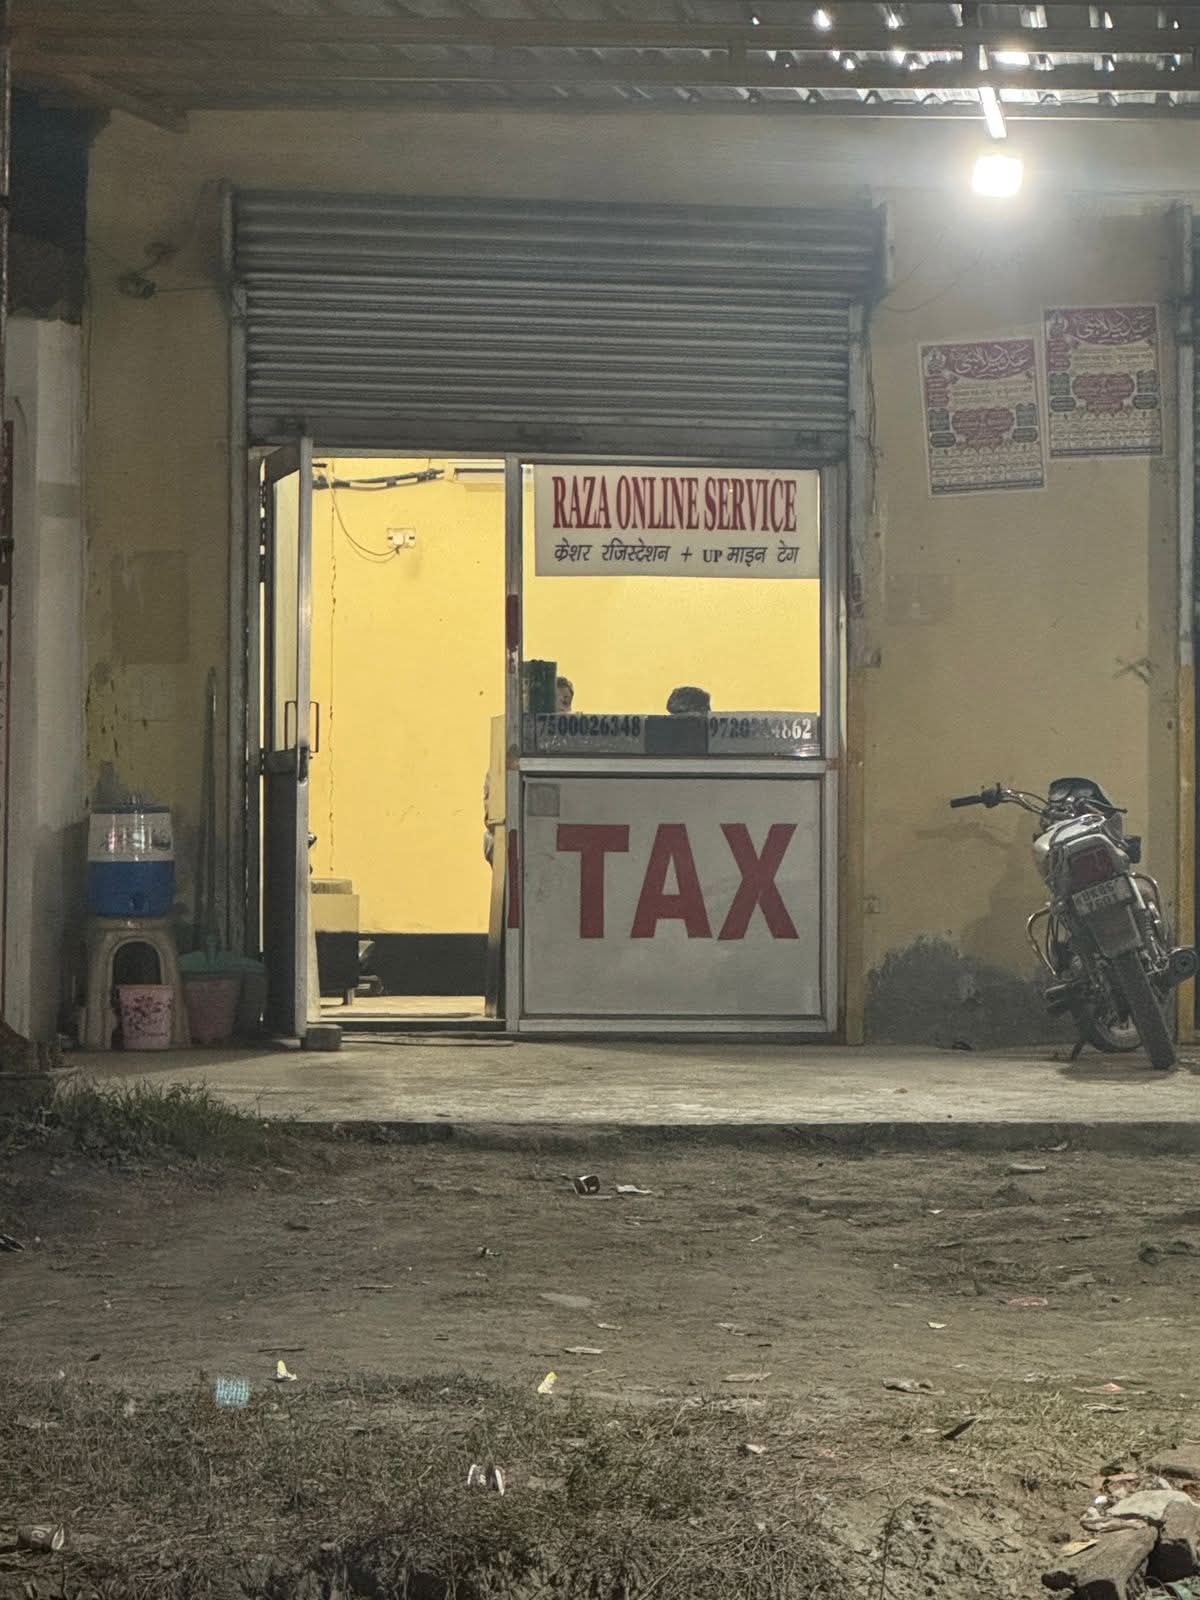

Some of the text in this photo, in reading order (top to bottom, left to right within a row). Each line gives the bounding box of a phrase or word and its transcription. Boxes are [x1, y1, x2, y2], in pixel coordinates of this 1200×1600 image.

[552, 475, 797, 533] RAZA ONLINE SERVICE
[703, 549, 723, 563] UP
[727, 546, 768, 567] माइन
[777, 539, 800, 564] टेग
[556, 823, 800, 940] TAX
